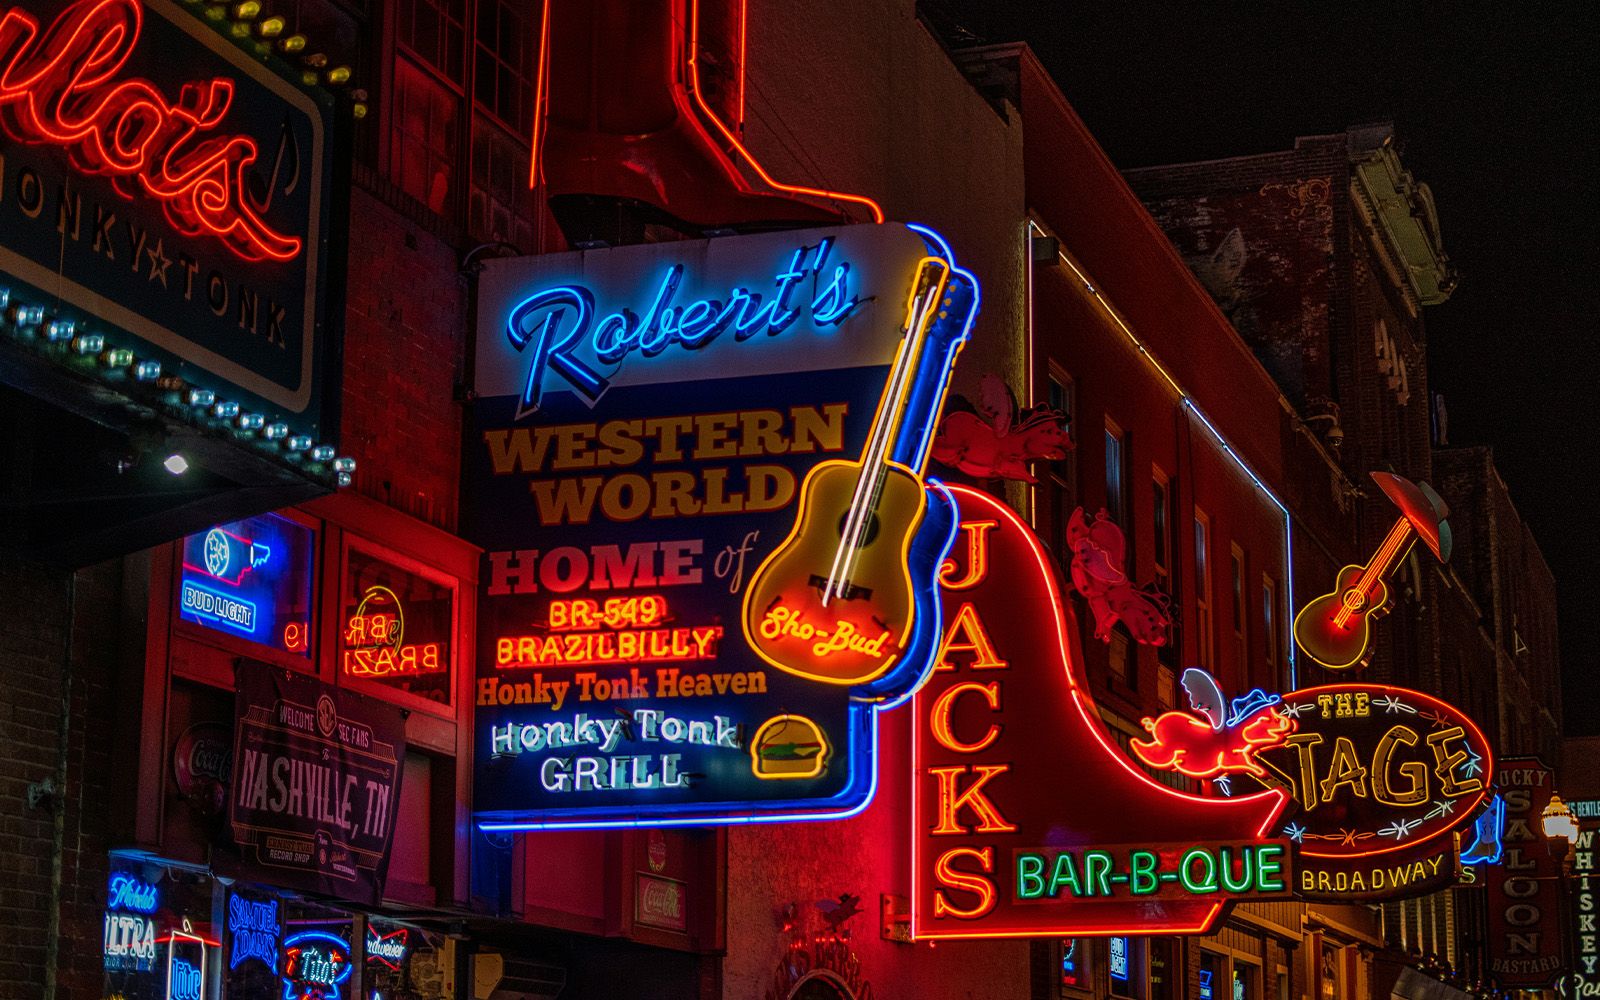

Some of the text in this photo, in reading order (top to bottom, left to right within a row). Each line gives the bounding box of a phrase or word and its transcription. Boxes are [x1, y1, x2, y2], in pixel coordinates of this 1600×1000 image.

[0, 157, 286, 350] ONKY TONK
[505, 236, 857, 418] Robert's
[485, 403, 848, 475] WESTERN
[530, 465, 797, 526] WORLD
[488, 530, 760, 595] HOME of
[184, 587, 252, 625] BUD LIGHT
[549, 597, 664, 630] BR-549
[496, 627, 723, 667] BRAZILBILLY
[760, 606, 891, 658] Sho-Bud
[477, 673, 570, 711] Honky
[575, 669, 650, 701] Tonk
[656, 670, 767, 698] Heaven
[1317, 692, 1371, 718] THE
[280, 705, 369, 749] WELCOME SEC FANS
[491, 708, 743, 757] Honky Tonk
[928, 518, 1020, 920] JACKS
[239, 749, 390, 839] NASHVILLE, TN
[540, 754, 692, 792] GRILL
[1500, 768, 1548, 788] UCKY
[270, 849, 310, 863] RECORD SHOP
[1016, 845, 1285, 898] BAR-B-QUE
[1301, 854, 1444, 892] BROADWAY
[1502, 789, 1541, 955] SALOON
[229, 894, 281, 937] SAMUEL
[1574, 831, 1598, 974] WHISKEY
[230, 929, 279, 974] ADAMS
[367, 936, 405, 958] udweiser
[1491, 956, 1561, 974] BASTARD
